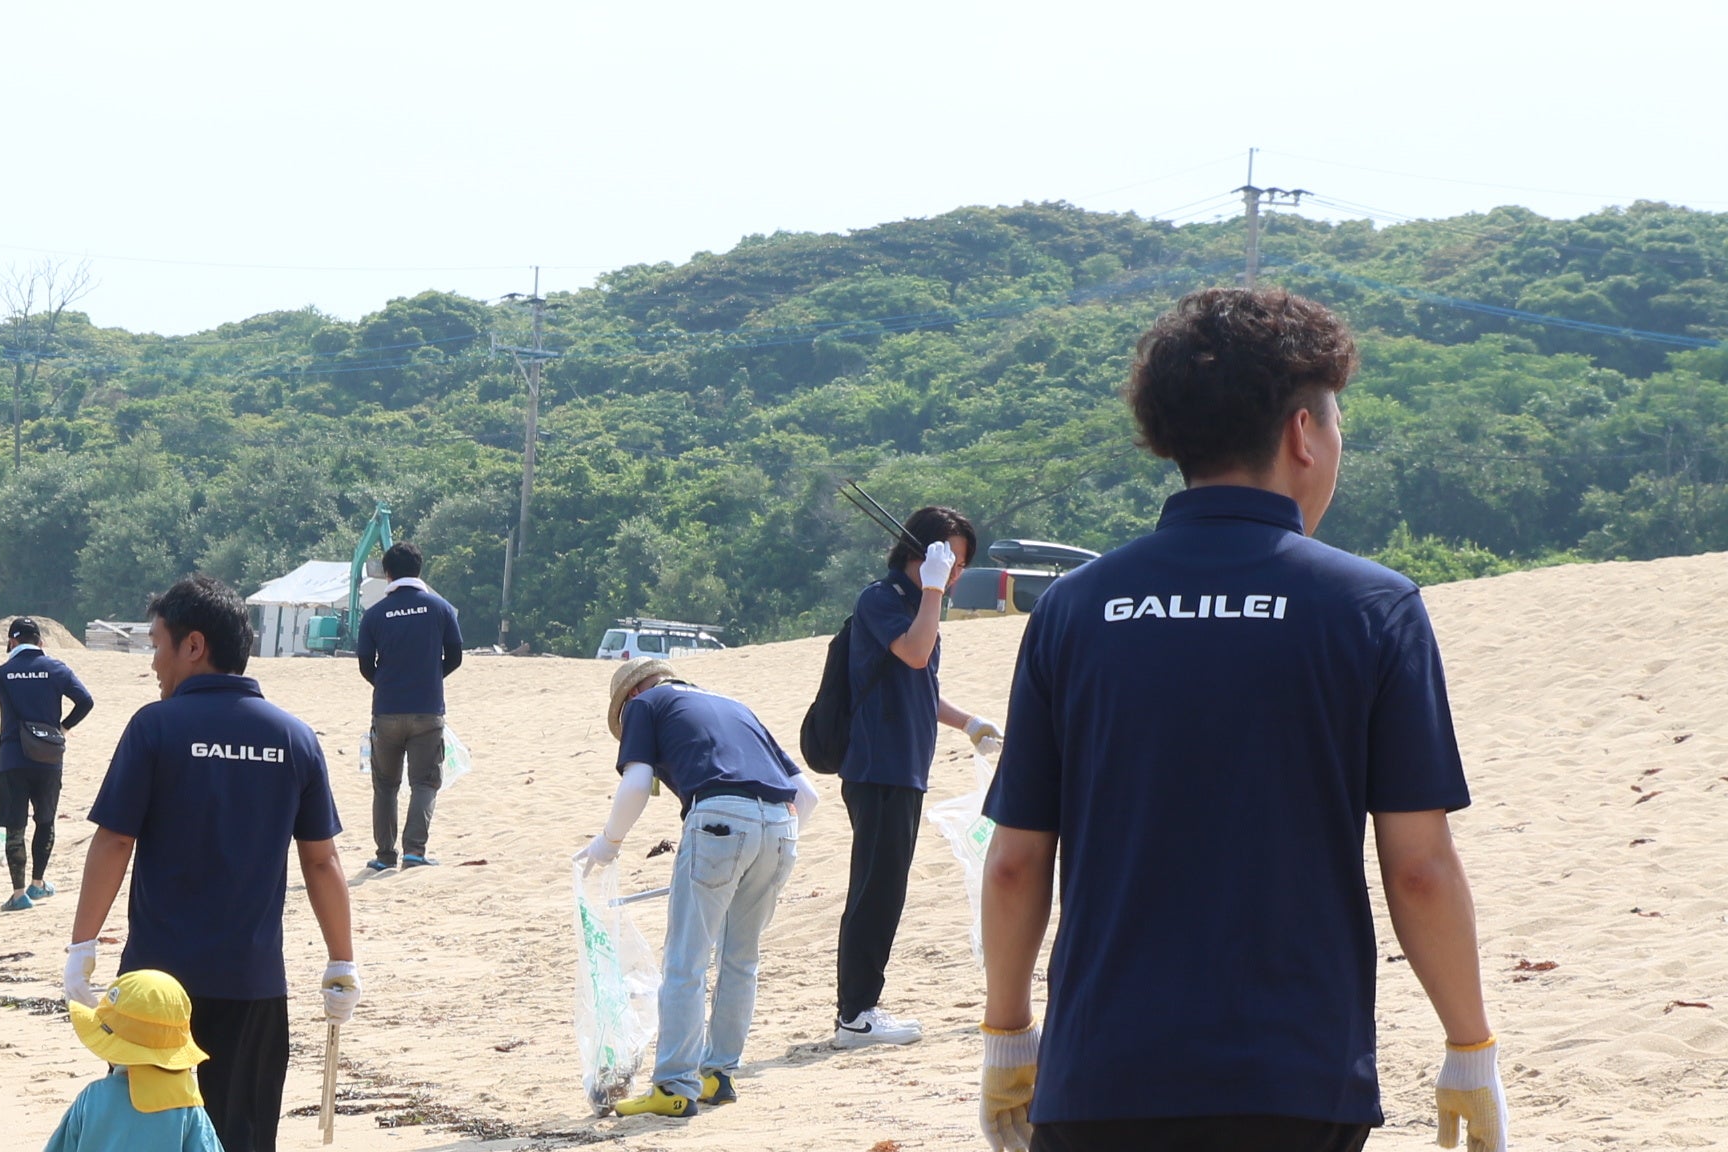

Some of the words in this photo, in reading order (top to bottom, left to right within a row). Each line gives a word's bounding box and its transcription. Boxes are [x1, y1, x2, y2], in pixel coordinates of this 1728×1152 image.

[385, 606, 428, 618] GALILEI
[1104, 594, 1288, 622] GALILEI
[6, 671, 49, 679] GALILEI
[191, 742, 284, 763] GALILEI
